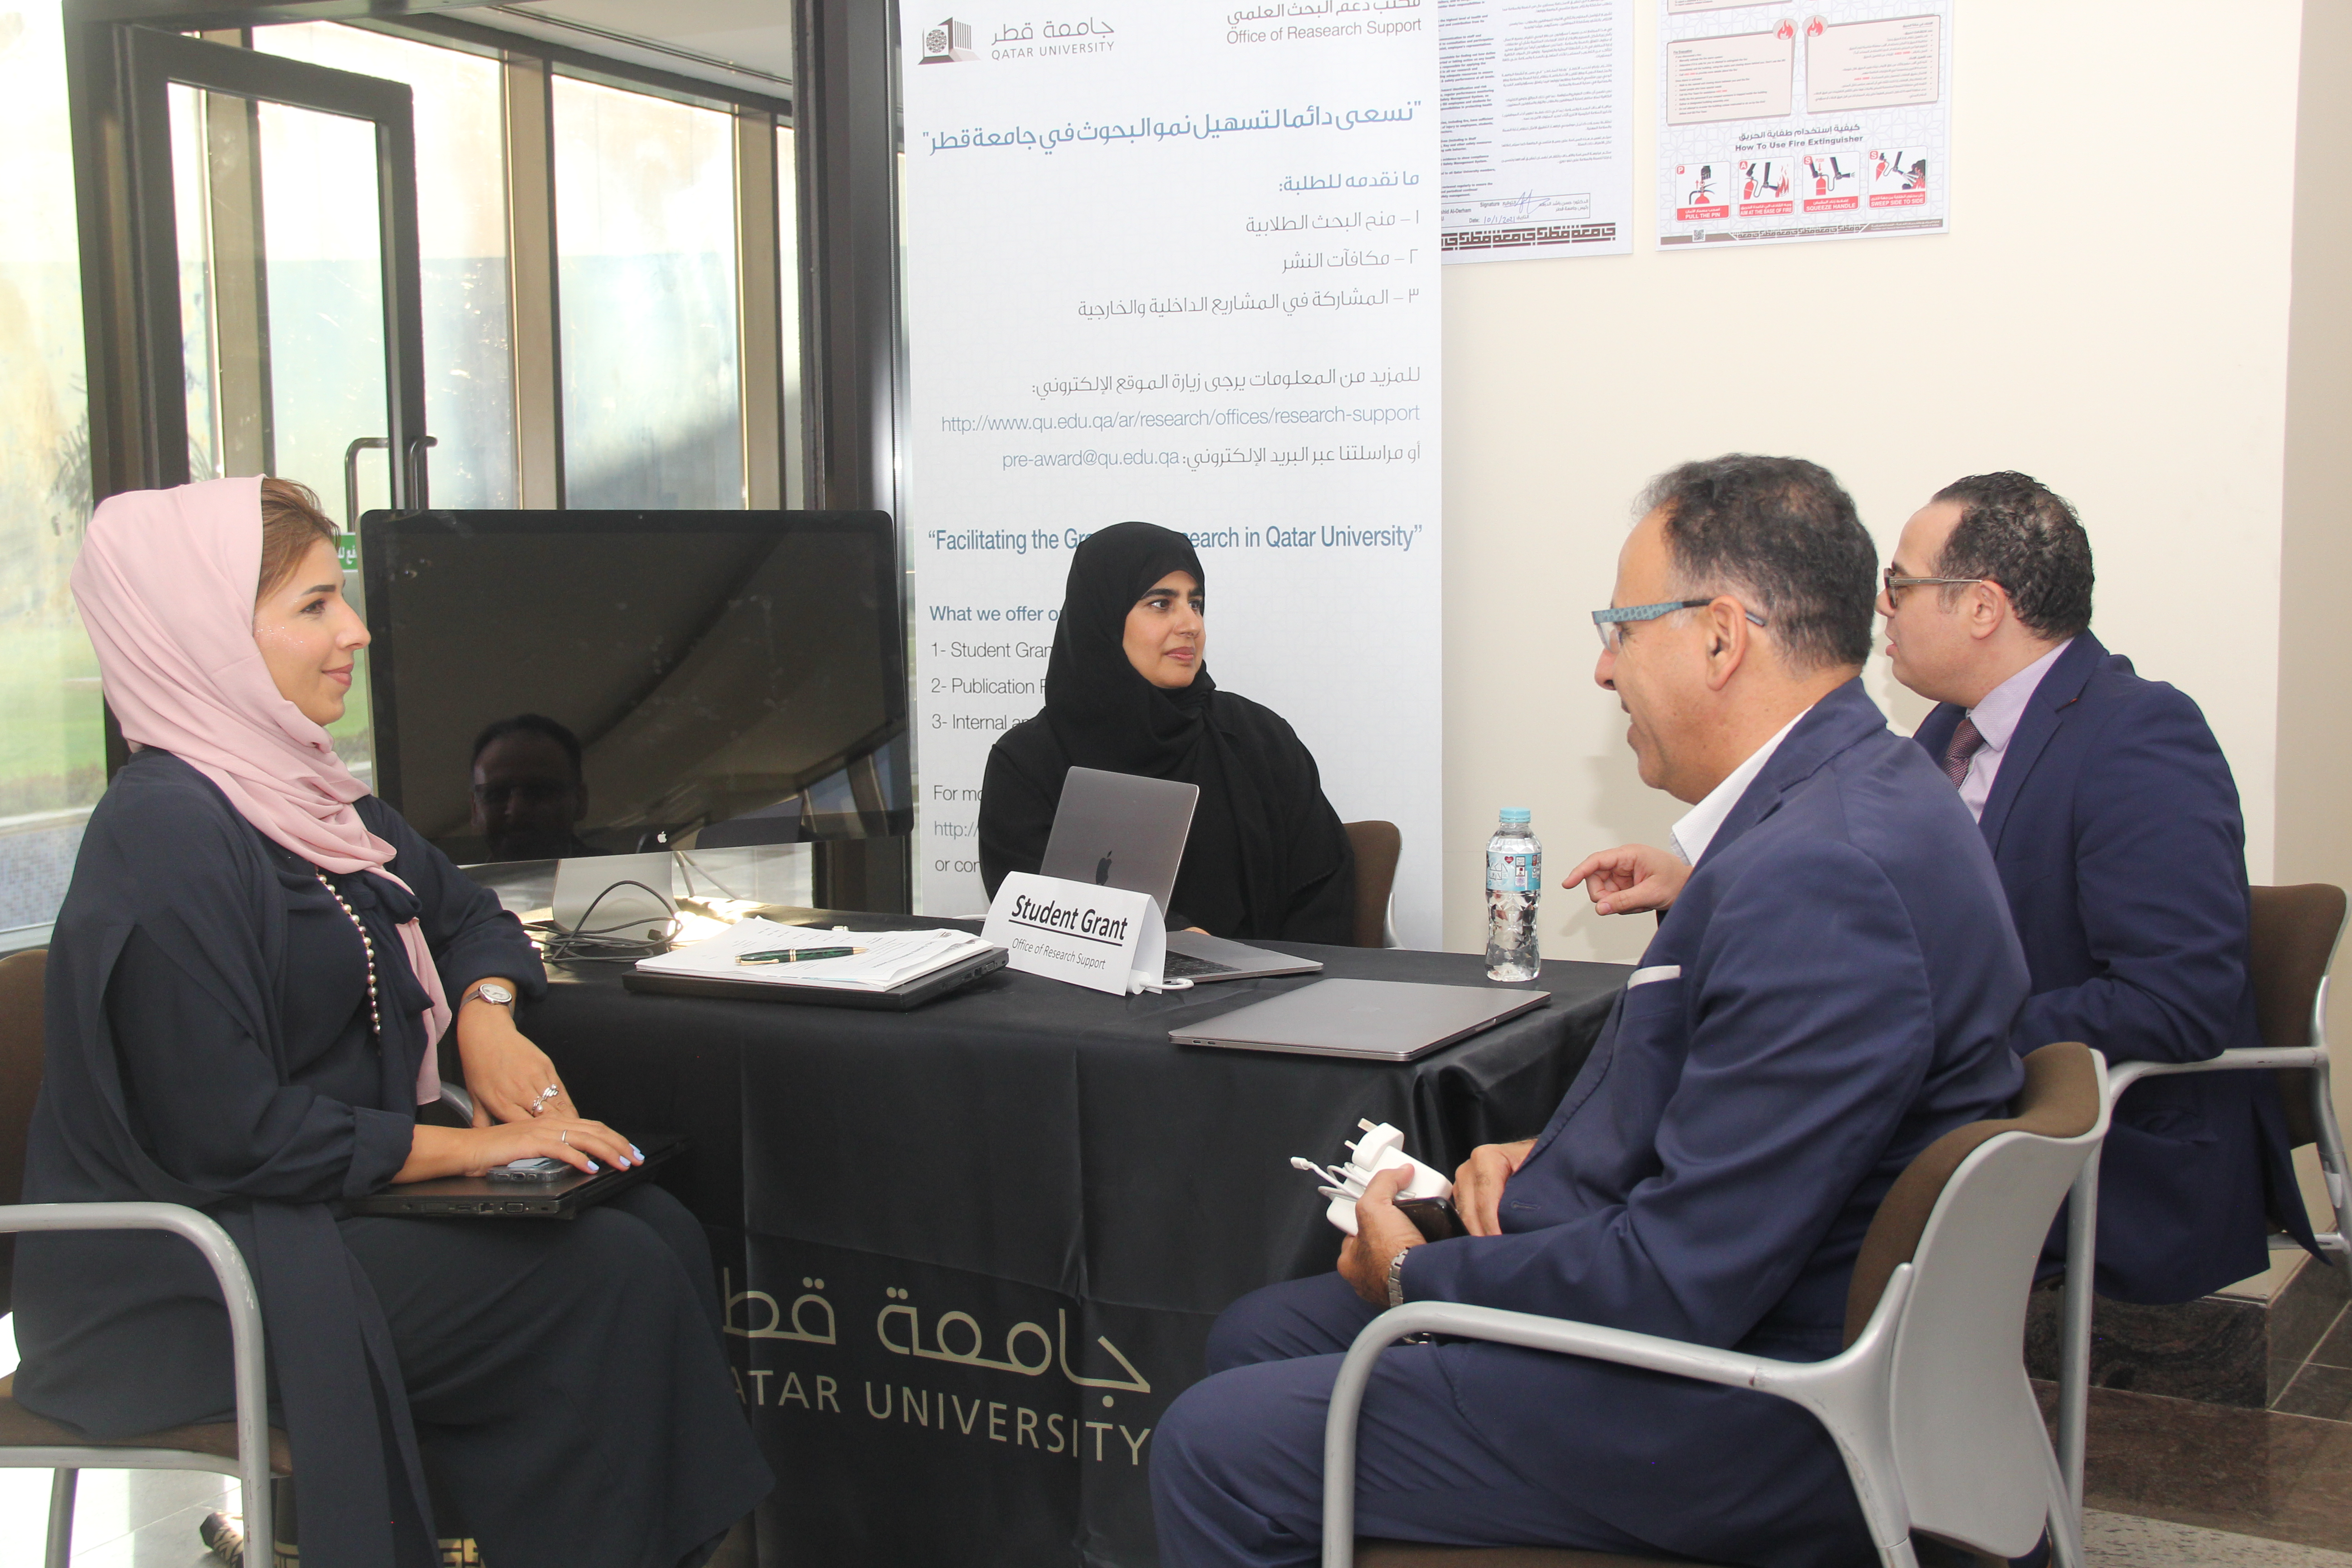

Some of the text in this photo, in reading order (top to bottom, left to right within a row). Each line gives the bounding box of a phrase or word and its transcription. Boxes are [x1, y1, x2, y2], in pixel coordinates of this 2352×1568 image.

[1227, 4, 1284, 29] العلمي
[1288, 0, 1332, 17] البحث
[1336, 3, 1370, 15] دعم
[991, 17, 1114, 45] جامعة قطر
[1227, 30, 1266, 44] Office
[1270, 27, 1283, 41] of
[1288, 22, 1362, 39] Reasearch
[1367, 19, 1421, 36] Support
[991, 41, 1114, 61] QATAR UNIVERSITY
[1077, 117, 1151, 145] البحوث
[1153, 115, 1191, 142] نمو
[1194, 108, 1280, 139] لتسهيل
[1767, 129, 1792, 138] طفاية
[1834, 124, 1860, 132] كيفية
[973, 126, 1036, 150] جامعة
[1039, 122, 1075, 155] في
[1739, 132, 1765, 141] الحريق
[1808, 136, 1863, 145] Extinguisher
[1345, 171, 1398, 187] نقدمه
[1403, 171, 1419, 185] ما
[1246, 215, 1308, 236] الطلابية
[1312, 212, 1361, 232] البحث
[1366, 211, 1395, 231] منح
[1282, 251, 1323, 274] النشر
[1327, 249, 1390, 267] مكافآت
[1149, 297, 1208, 318] الداخلية
[1212, 292, 1279, 315] المشاريع
[1283, 292, 1308, 316] في
[1312, 287, 1388, 309] المشاركة
[1078, 299, 1146, 320] والخارجية
[1117, 374, 1167, 393] الموقع
[1173, 372, 1200, 393] زيارة
[1205, 376, 1245, 392] يرجى
[1250, 368, 1336, 390] المعلومات
[1340, 370, 1365, 387] من
[1370, 366, 1420, 387] للمزيد
[941, 404, 1421, 433] http://www.qu.edu.qa/ar/research/offices/research-support
[1003, 448, 1180, 470] pre-award@qu.edu.qa
[1269, 446, 1309, 466] البريد
[1310, 447, 1334, 465] عبر
[1338, 443, 1403, 463] مراسلتنا
[1407, 441, 1421, 464] أو
[1031, 529, 1059, 549] the
[1181, 526, 1240, 548] earch
[1245, 526, 1260, 548] in
[1266, 525, 1316, 549] Qatar
[929, 606, 1062, 621] What we offer o
[931, 642, 946, 657] 1-
[951, 642, 1011, 657] Student
[931, 678, 946, 693] 2-
[952, 678, 1035, 694] Publication
[932, 714, 947, 729] 3-
[953, 714, 1007, 730] Internal
[934, 785, 958, 801] For
[935, 860, 951, 872] or
[1011, 895, 1128, 941] Student Grant
[1012, 938, 1106, 970] Office of Research Support
[877, 1286, 1151, 1408] جامعة
[865, 1381, 1151, 1465] UNIVERSITY
